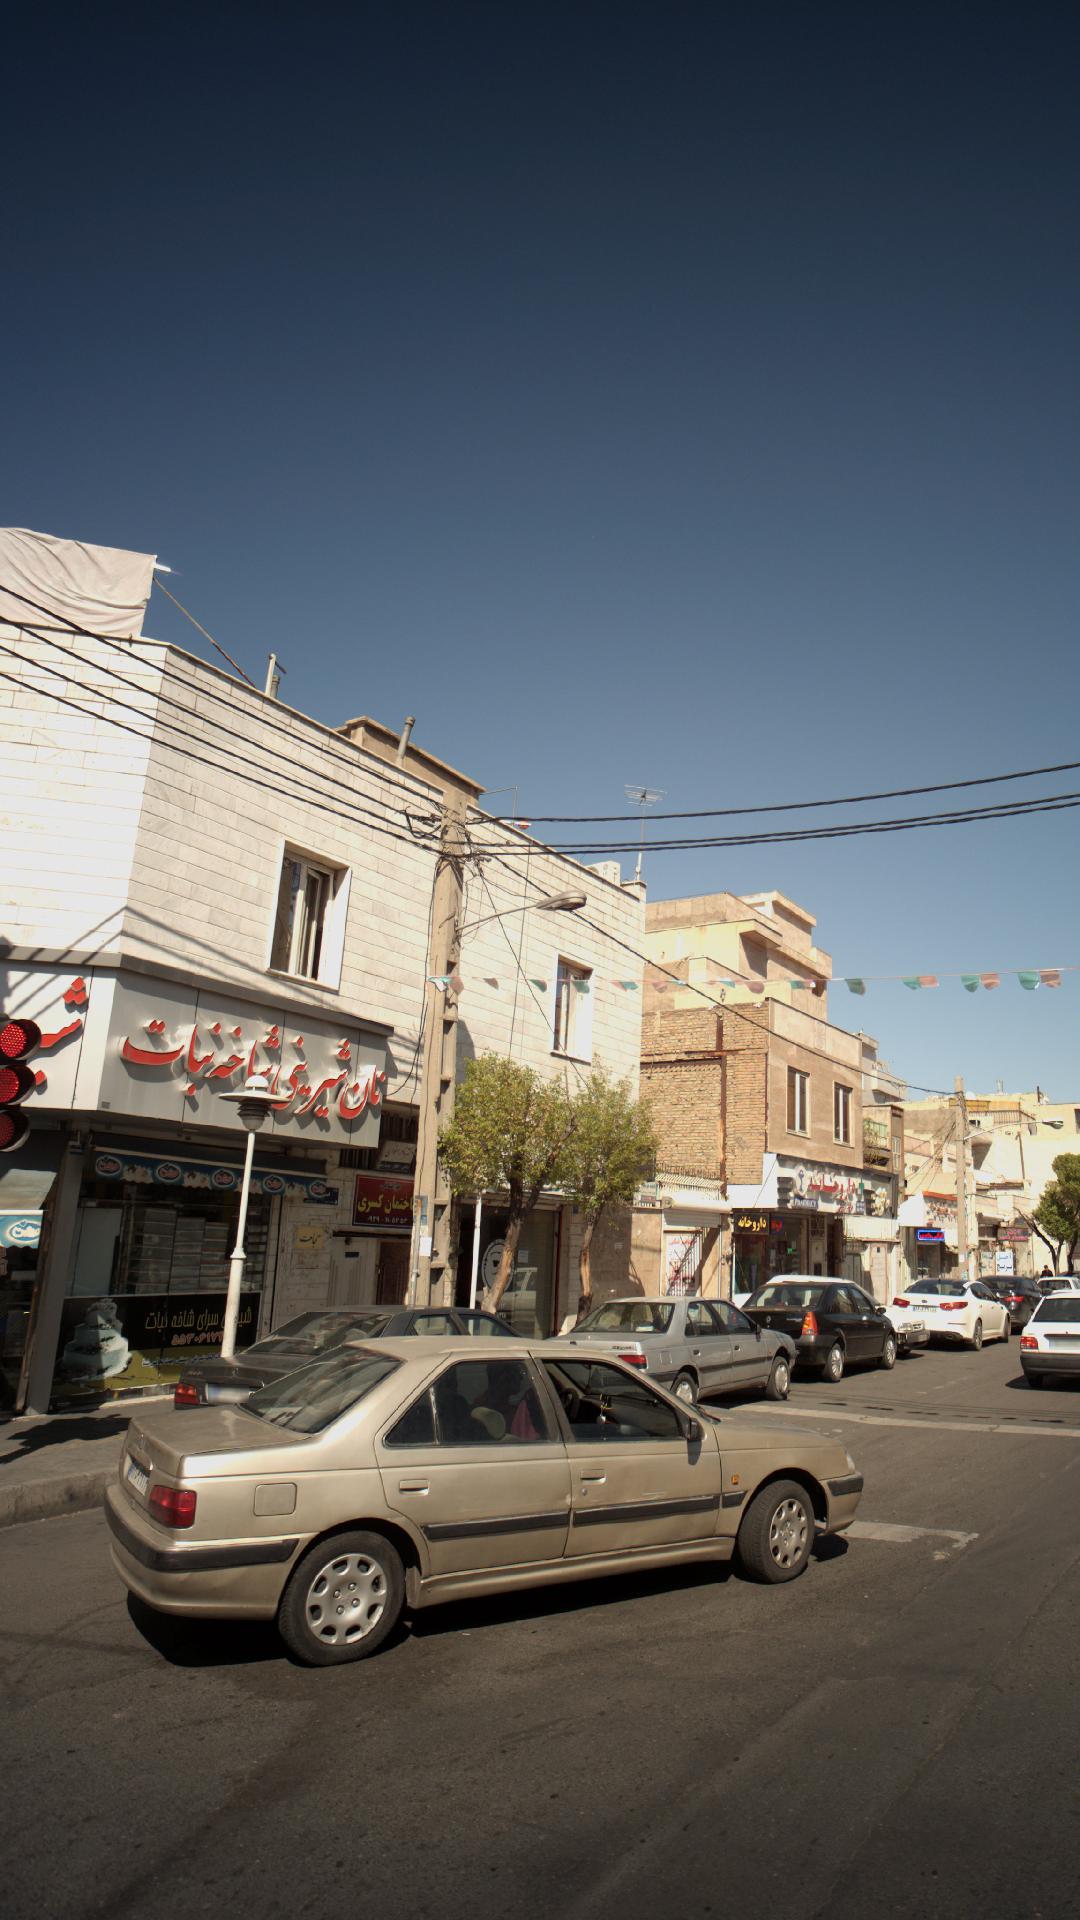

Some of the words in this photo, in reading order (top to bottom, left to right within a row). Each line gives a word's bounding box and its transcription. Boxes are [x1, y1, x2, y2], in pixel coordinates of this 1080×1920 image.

[122, 1019, 222, 1097] نبات
[207, 1024, 279, 1080] شاخه
[338, 1065, 385, 1119] نان
[738, 1215, 767, 1231] داروخانه
